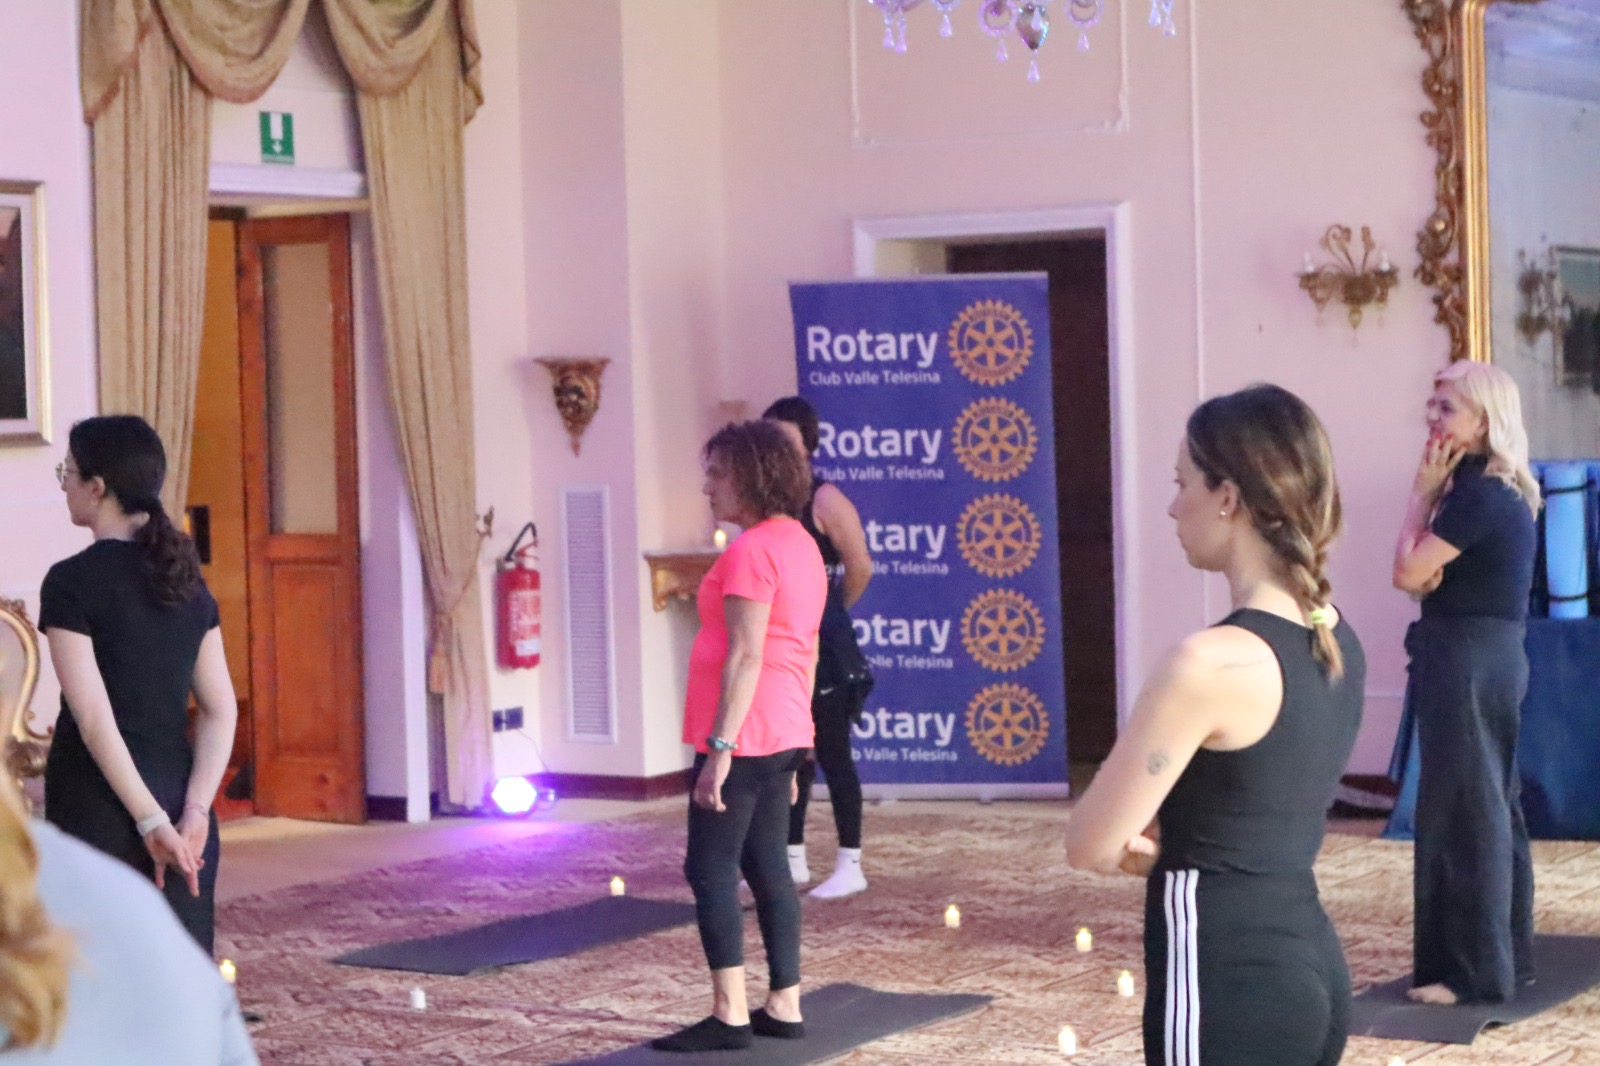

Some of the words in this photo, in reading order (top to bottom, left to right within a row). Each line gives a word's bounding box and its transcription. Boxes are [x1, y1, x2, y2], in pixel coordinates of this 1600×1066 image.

[806, 325, 939, 368] Rotary
[809, 371, 842, 385] Club
[844, 371, 880, 384] Valle
[882, 369, 941, 383] Telesina
[812, 421, 943, 464] Rotary
[848, 466, 884, 480] Valle
[886, 464, 945, 480] Telesina
[865, 519, 947, 560] tary
[871, 560, 890, 575] lle
[892, 560, 949, 575] Telesina
[851, 614, 951, 654] otary
[896, 654, 954, 669] Telesina
[852, 706, 956, 747] otary
[863, 746, 899, 761] Valle
[900, 747, 958, 761] Telesina
